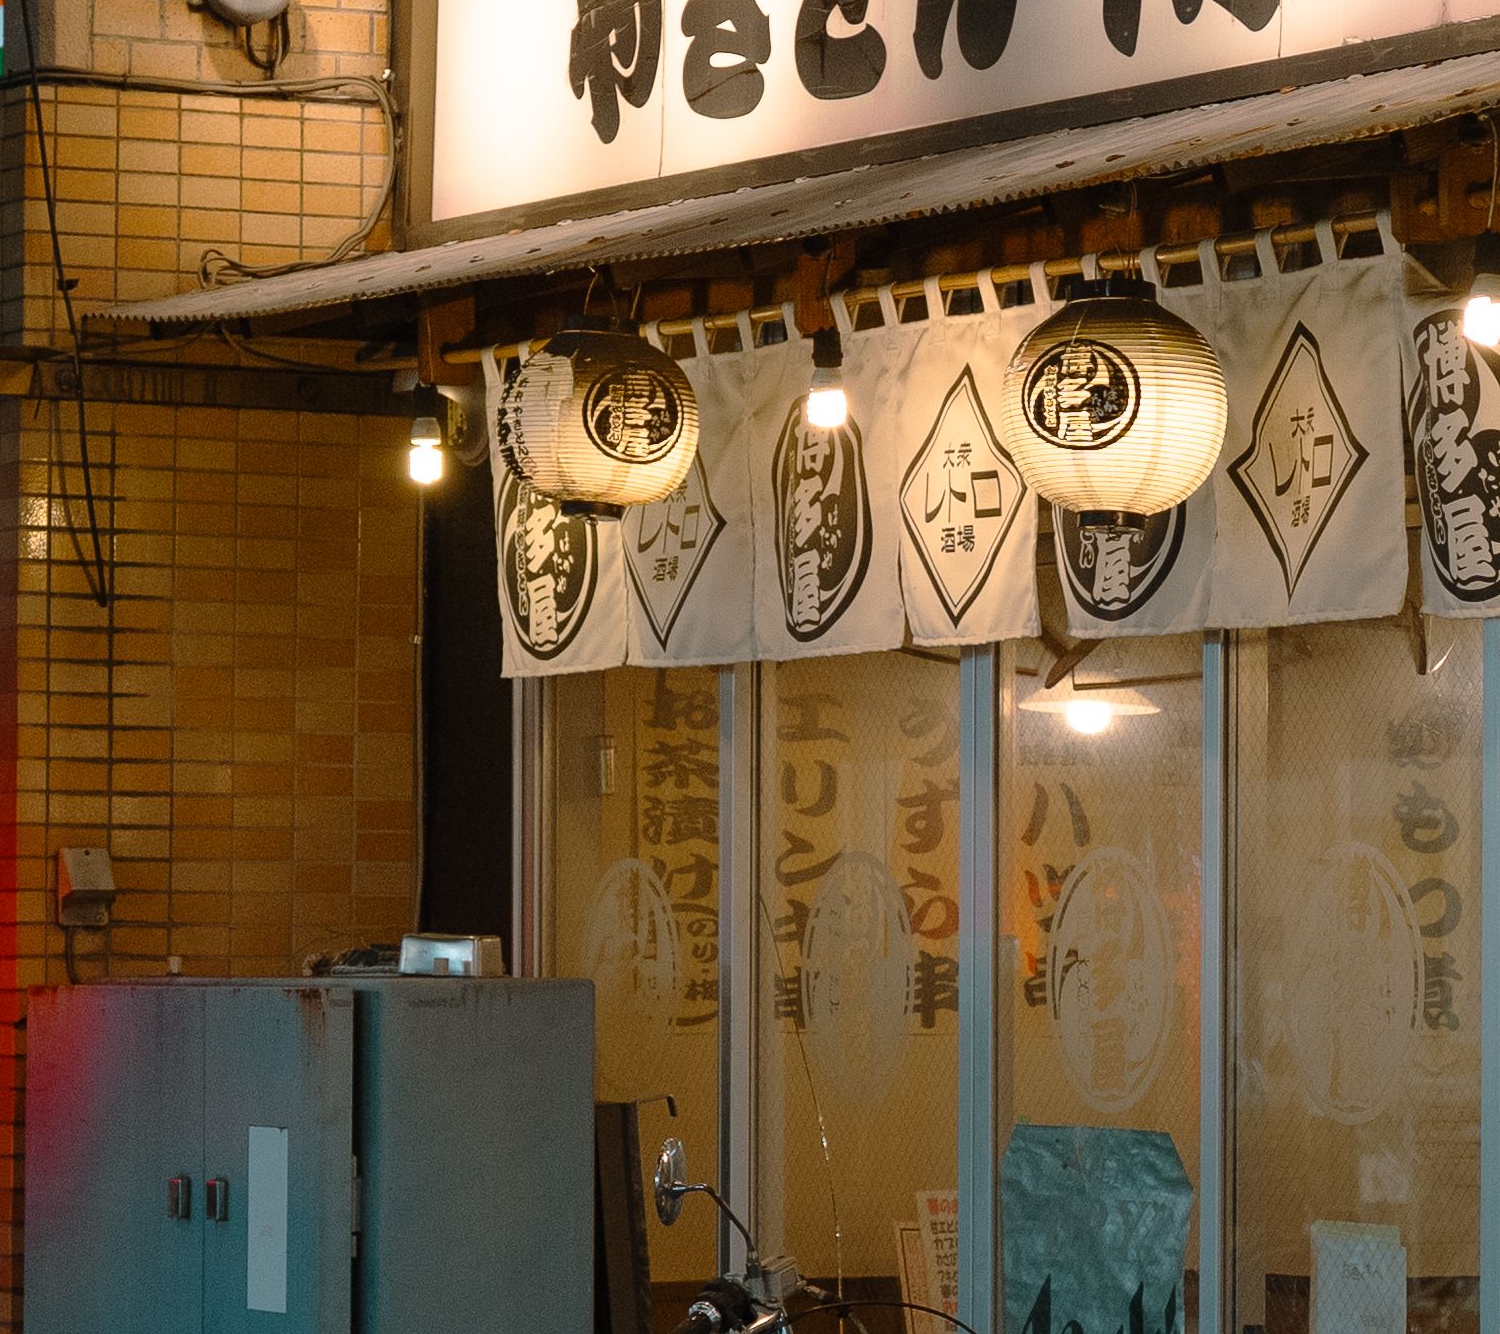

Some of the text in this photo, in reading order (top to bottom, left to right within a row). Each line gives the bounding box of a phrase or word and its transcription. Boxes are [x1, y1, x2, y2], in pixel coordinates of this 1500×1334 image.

[942, 442, 973, 469] 大衆
[1268, 433, 1336, 497] レトロ
[1424, 319, 1499, 585] 博多屋
[925, 469, 1002, 524] レトロ
[638, 504, 700, 554] レトロ
[941, 524, 976, 554] 酒場
[525, 491, 559, 647] 多屋
